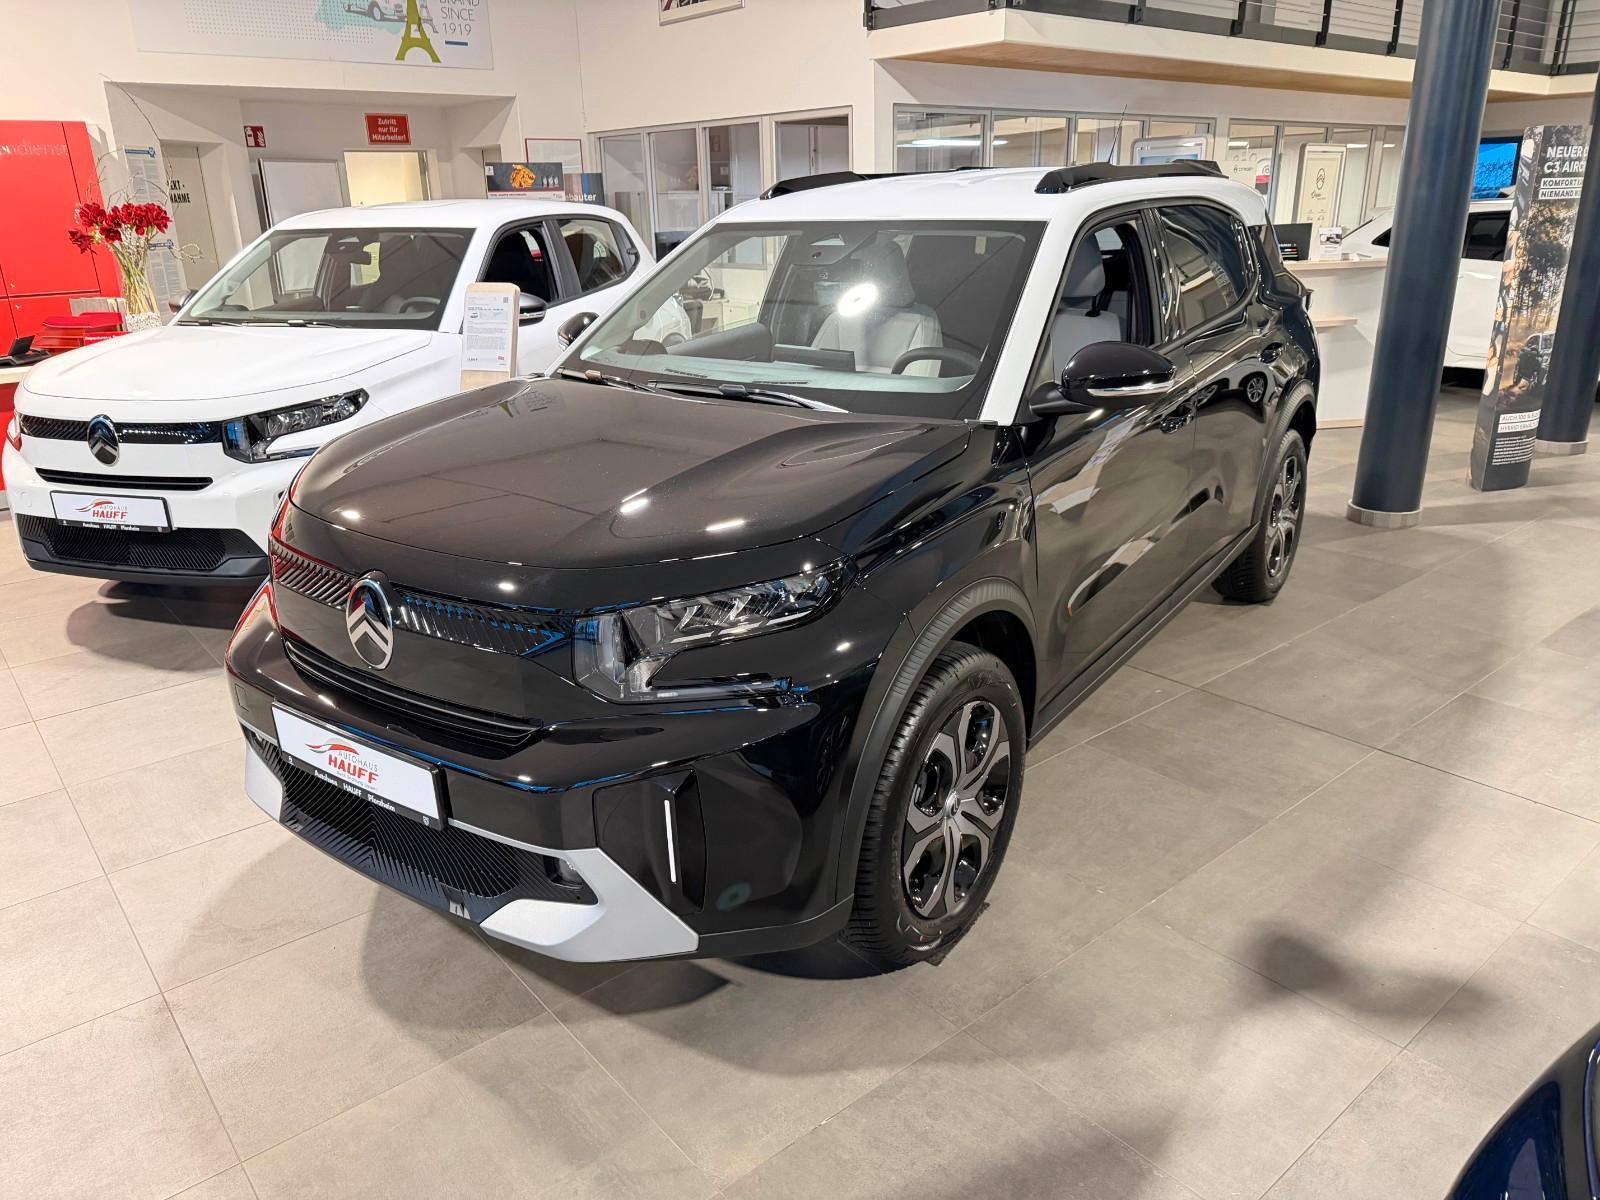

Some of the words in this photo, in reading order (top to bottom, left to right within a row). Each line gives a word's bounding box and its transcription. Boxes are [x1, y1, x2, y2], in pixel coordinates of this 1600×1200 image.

[440, 7, 475, 21] SINCE
[442, 22, 472, 36] 1919
[1546, 144, 1583, 158] NEUER
[1543, 161, 1560, 174] C3
[92, 510, 127, 519] HAUFF
[328, 753, 380, 784] HAUFF
[338, 751, 379, 772] AUTOHAUS
